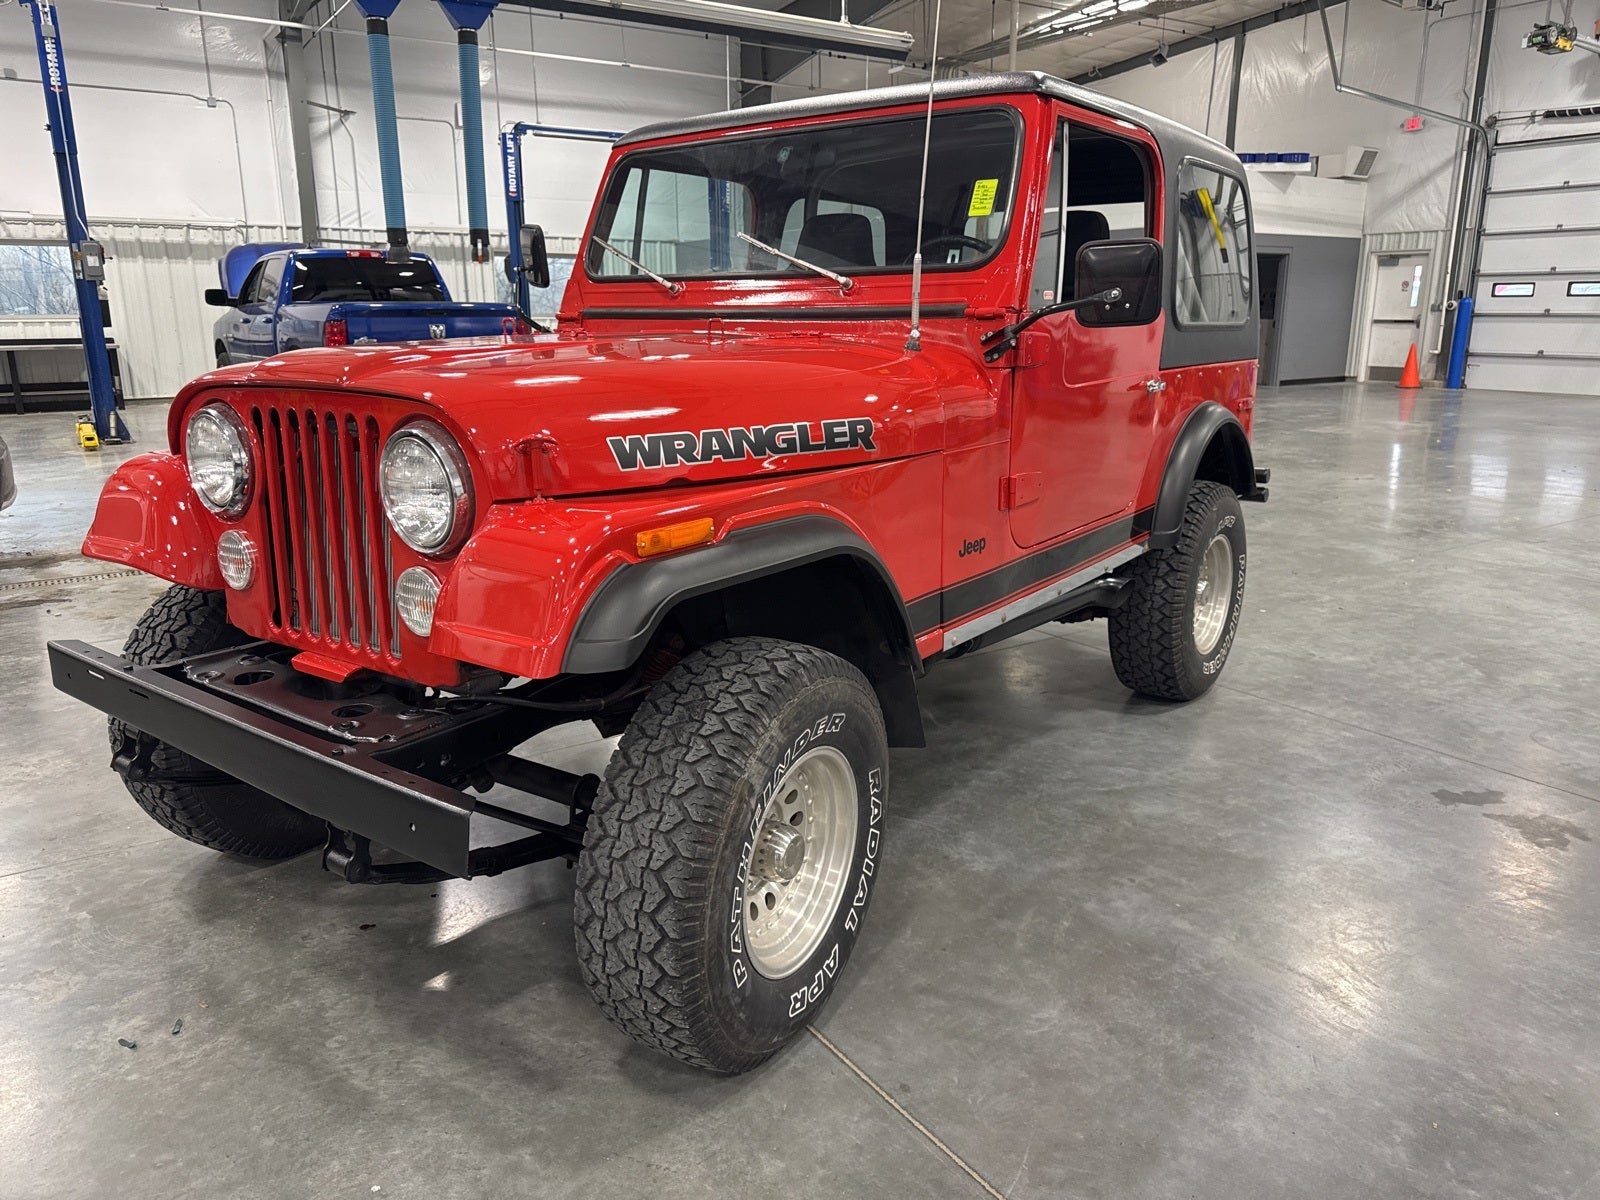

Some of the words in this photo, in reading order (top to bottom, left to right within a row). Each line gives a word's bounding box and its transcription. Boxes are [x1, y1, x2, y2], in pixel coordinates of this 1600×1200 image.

[507, 155, 517, 192] ROTARY
[606, 417, 878, 472] WRANGLER
[958, 537, 986, 558] Jeep
[845, 767, 882, 932] RADIAL
[788, 943, 840, 1018] APR
